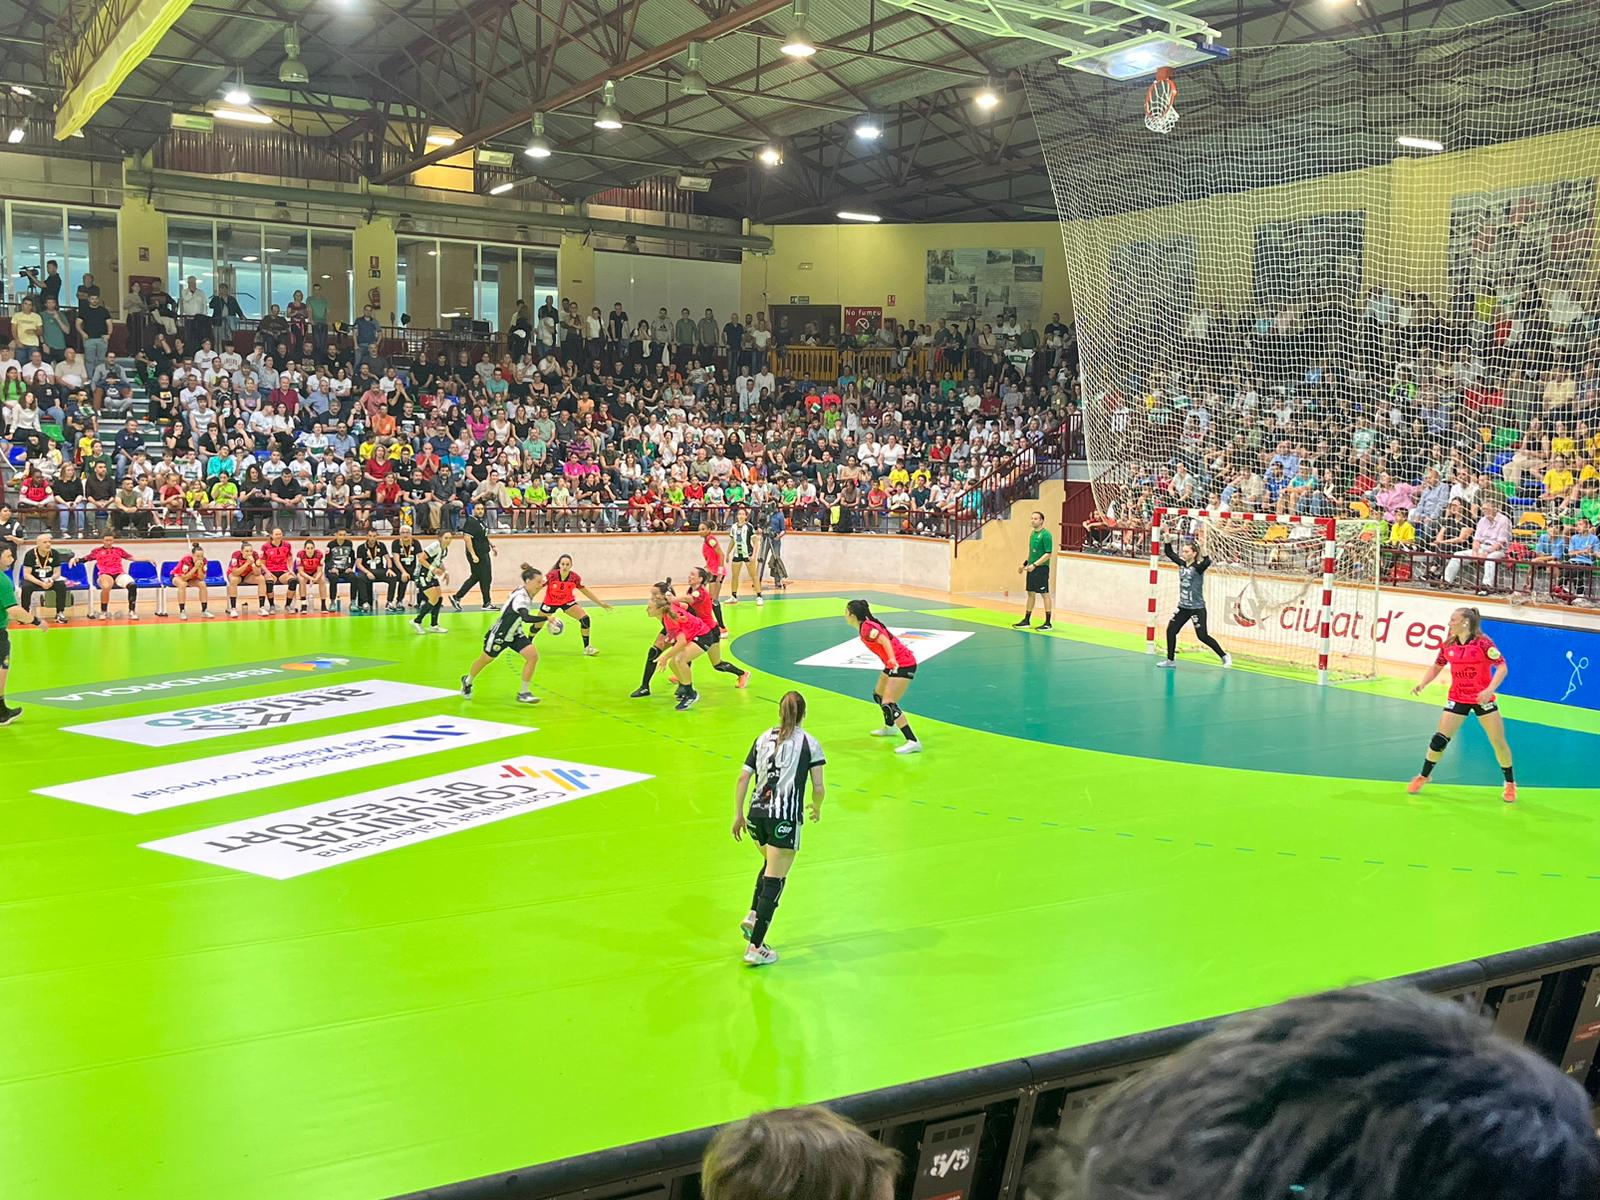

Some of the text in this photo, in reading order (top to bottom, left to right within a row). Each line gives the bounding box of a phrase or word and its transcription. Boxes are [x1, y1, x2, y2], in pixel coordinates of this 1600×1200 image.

[1280, 600, 1364, 639] ciuat
[42, 667, 284, 701] IBERDROLA
[131, 743, 405, 799] Diputación Provincial
[251, 739, 376, 765] de Málaga
[204, 781, 488, 853] DE L'ESPORT
[280, 785, 537, 852] COMUNITAT
[313, 791, 566, 858] Comunitat Valenciana
